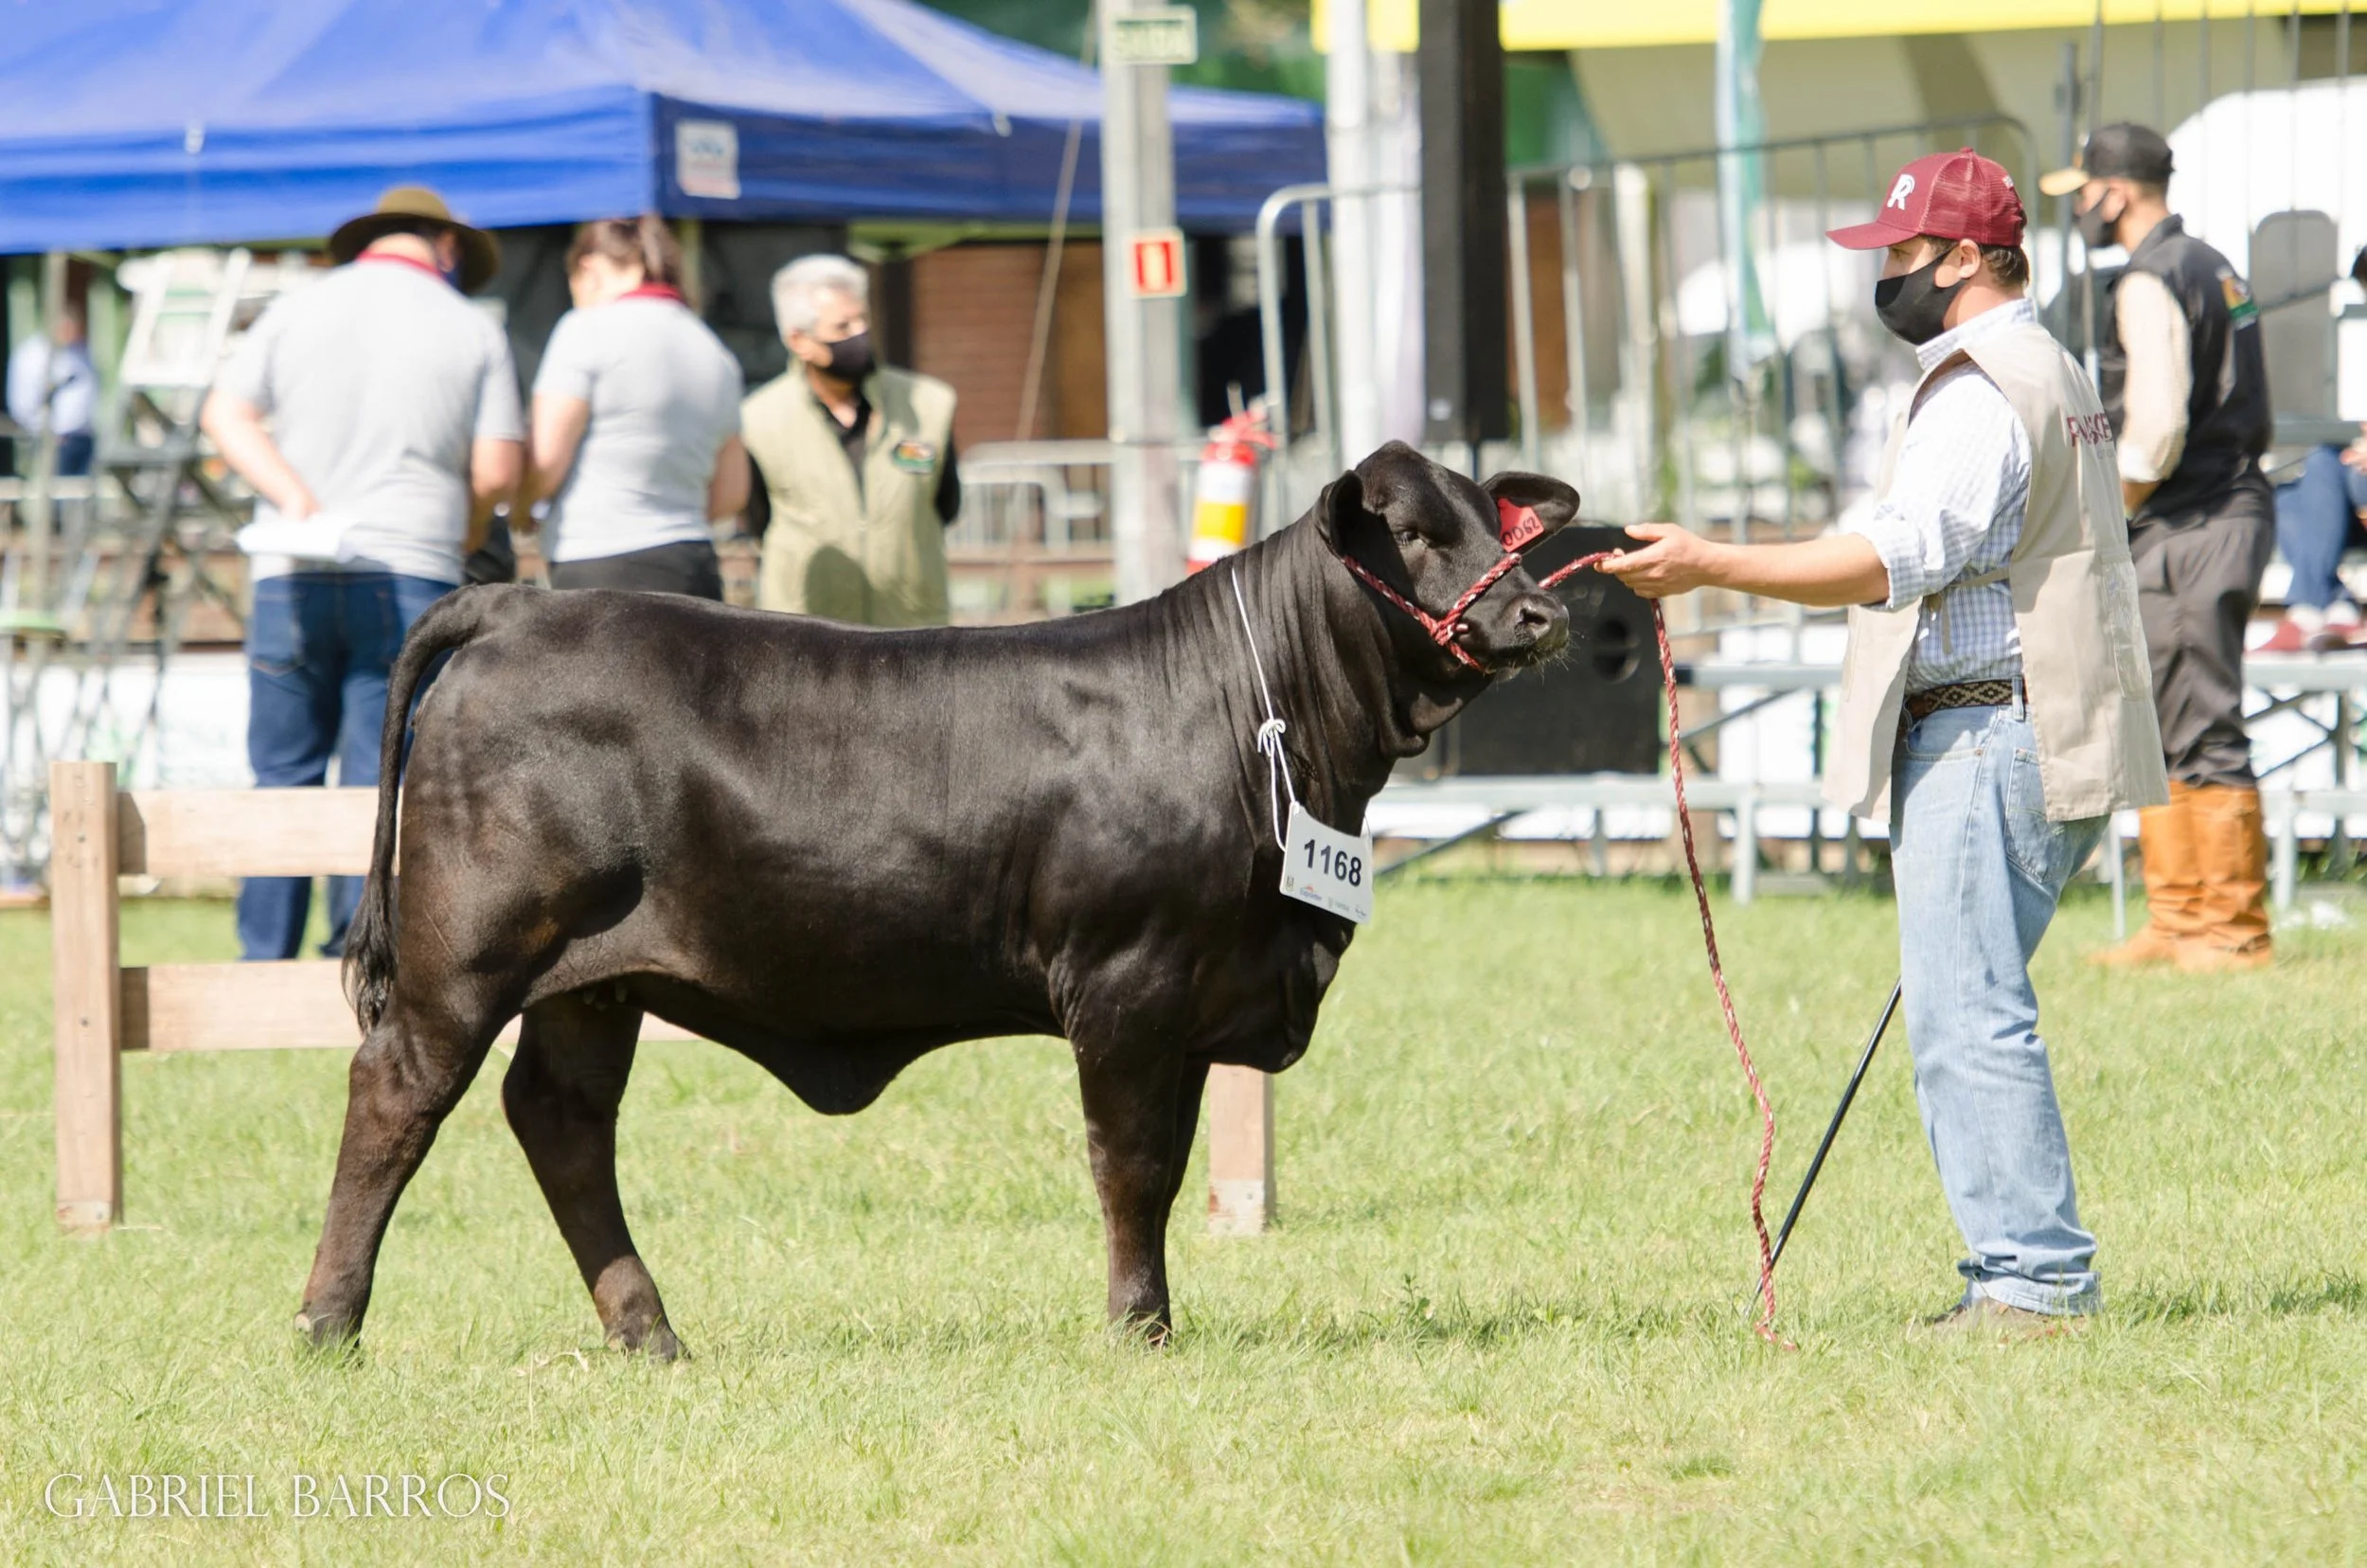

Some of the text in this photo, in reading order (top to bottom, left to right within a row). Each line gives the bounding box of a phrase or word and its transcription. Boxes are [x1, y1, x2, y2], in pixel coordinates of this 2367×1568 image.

[1887, 174, 1915, 210] R
[1502, 517, 1539, 546] 0062
[1304, 839, 1361, 887] 1168
